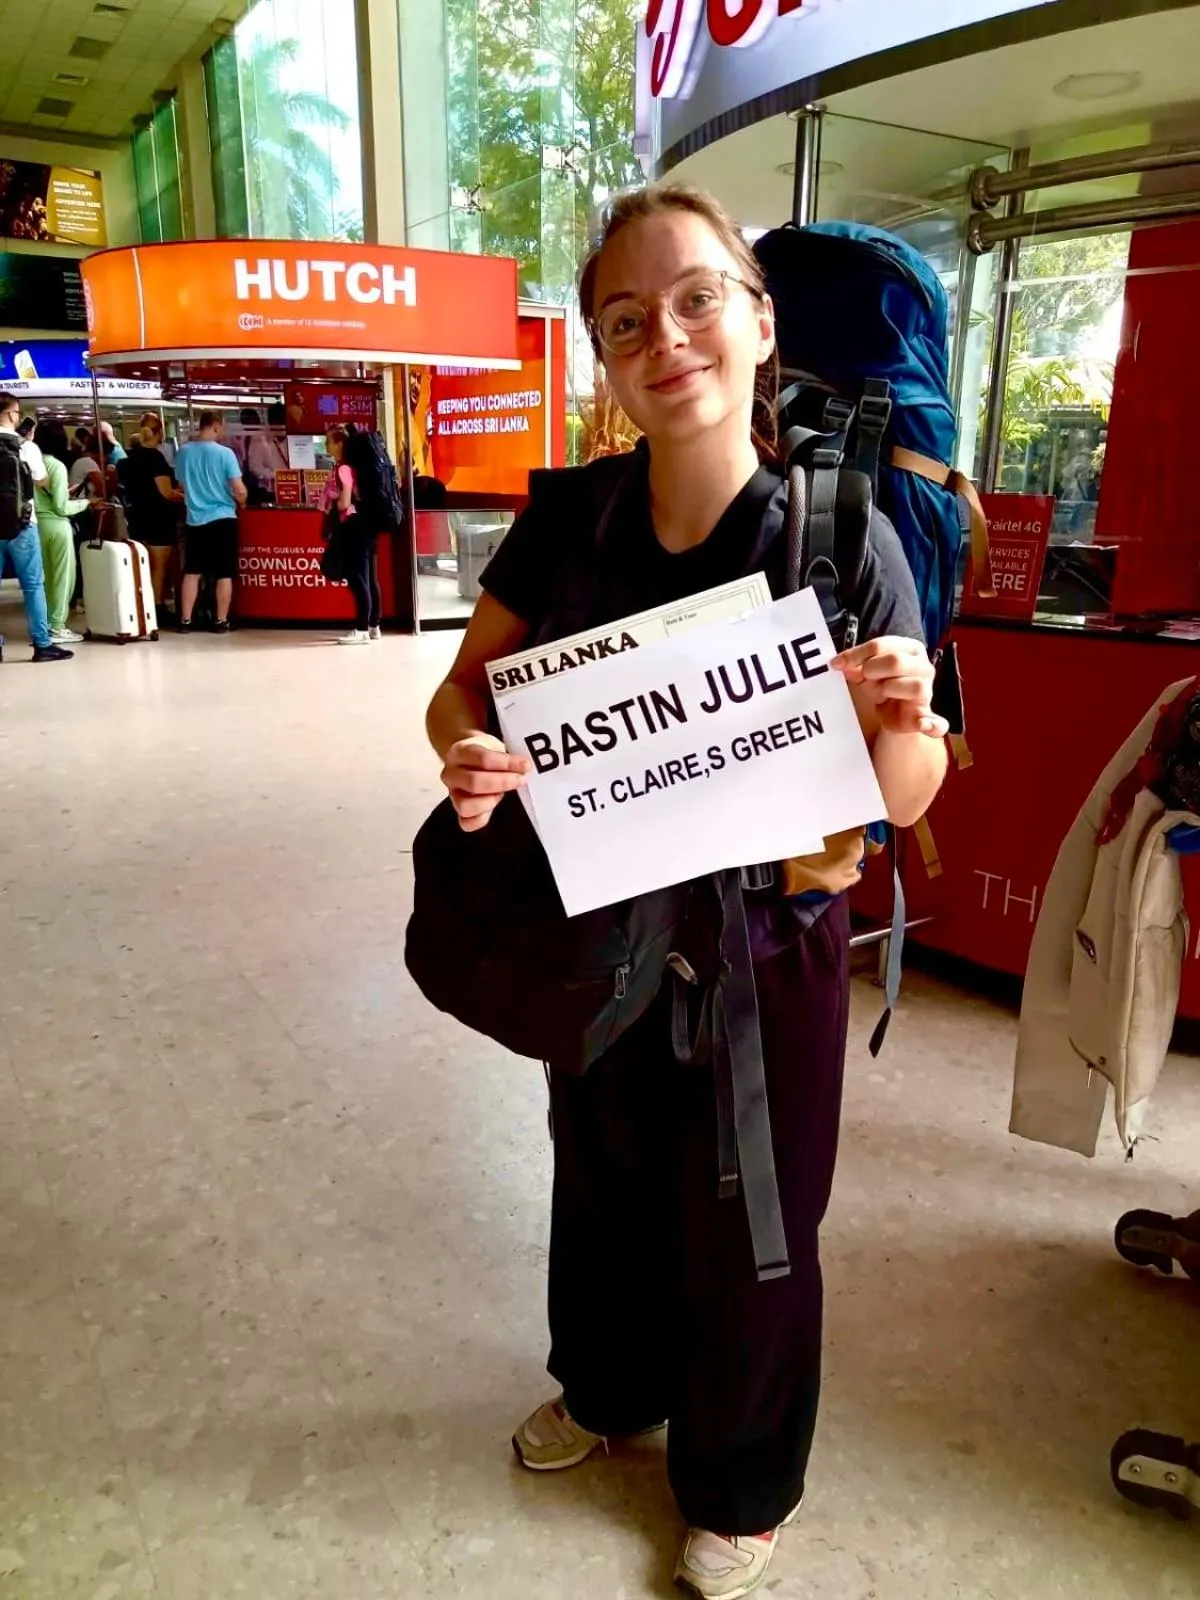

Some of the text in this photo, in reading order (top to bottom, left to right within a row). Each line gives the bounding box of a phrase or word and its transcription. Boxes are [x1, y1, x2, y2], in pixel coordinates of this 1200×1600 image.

[234, 258, 417, 307] HUTCH
[437, 390, 541, 415] KEEPING YOU CONNECTED
[438, 416, 529, 435] ALL ACROSS SRI LANKA
[993, 518, 1041, 533] airtel 4G
[990, 547, 1030, 559] ERVICES
[238, 557, 321, 571] DOWNLOA
[991, 561, 1028, 571] AILABLE
[240, 574, 267, 587] THE
[272, 574, 326, 588] HUTCH
[993, 572, 1026, 591] ERE
[492, 631, 639, 691] SRI LANKA
[524, 633, 829, 773] BASTIN JULIE
[568, 710, 825, 818] ST. CLAIRE,S GREEN
[974, 869, 1037, 922] TH
